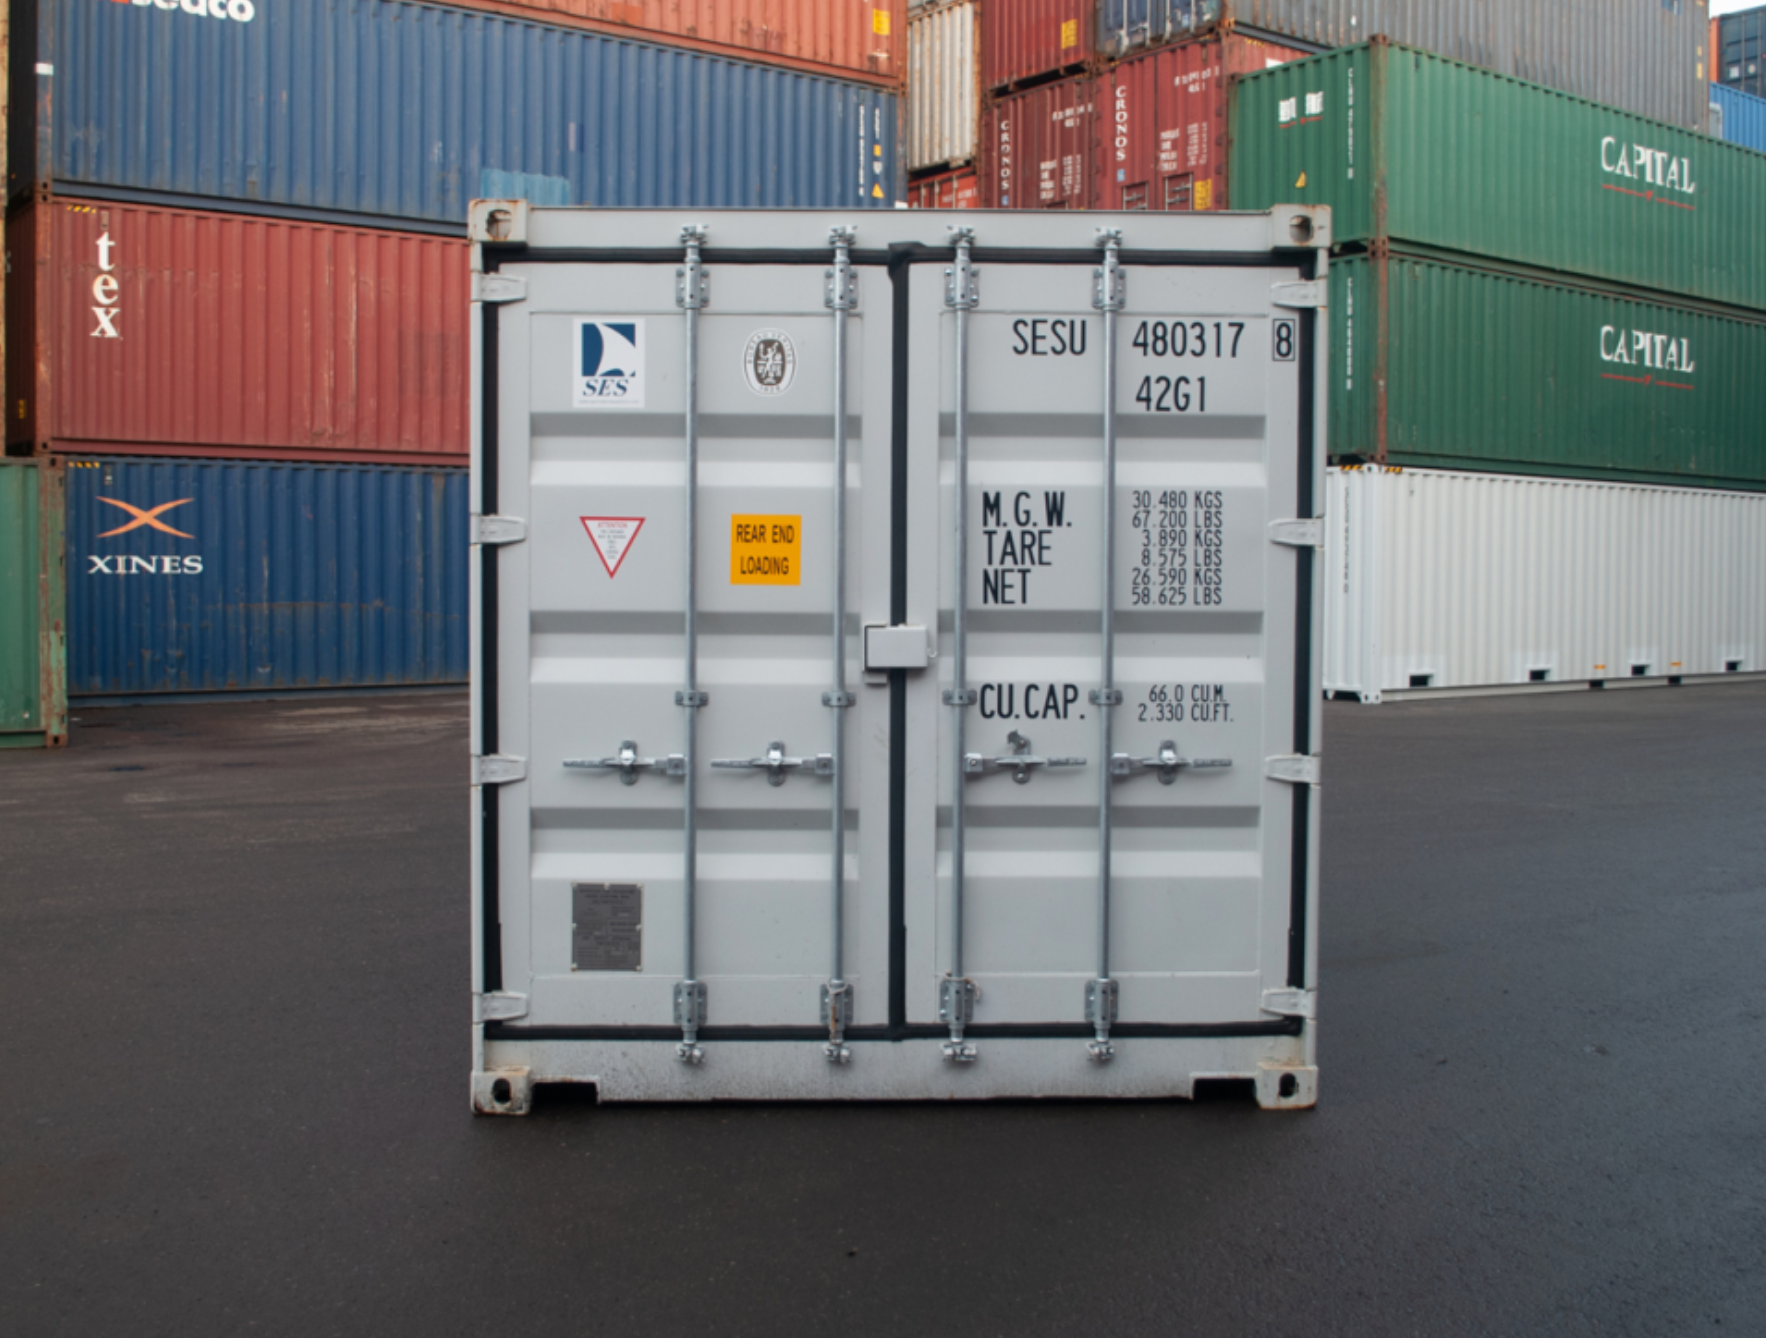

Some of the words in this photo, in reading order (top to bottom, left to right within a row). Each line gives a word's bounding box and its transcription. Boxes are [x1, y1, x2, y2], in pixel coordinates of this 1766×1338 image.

[1115, 85, 1128, 161] CRONOS
[1000, 120, 1012, 190] CRONOS
[1601, 136, 1695, 194] CAPITAL
[90, 231, 121, 338] tex
[1012, 319, 1087, 356] SESU
[1132, 320, 1245, 358] 480317
[1275, 322, 1293, 358] 8
[1600, 325, 1694, 373] CAPITAL
[582, 379, 629, 396] SES
[1135, 375, 1206, 412] 42G1
[1132, 491, 1187, 509] 30.480
[1194, 491, 1222, 509] KGS
[1132, 510, 1187, 528] 67.200
[1194, 510, 1222, 528] LBS
[736, 524, 767, 543] REAR
[772, 525, 795, 543] END
[982, 530, 1053, 566] TARE
[1142, 529, 1187, 547] 3.890
[1194, 529, 1222, 547] KGS
[1141, 548, 1187, 567] 8.575
[1194, 548, 1222, 567] LBS
[88, 555, 204, 575] XINES
[740, 556, 789, 575] LOADING
[982, 569, 1032, 604] NET
[1132, 567, 1187, 586] 26.590
[1193, 567, 1222, 586] KGS
[1132, 586, 1187, 605] 58.625
[1193, 586, 1222, 605] LBS
[1149, 684, 1184, 702] 66.0
[1138, 703, 1184, 722] 2.330
